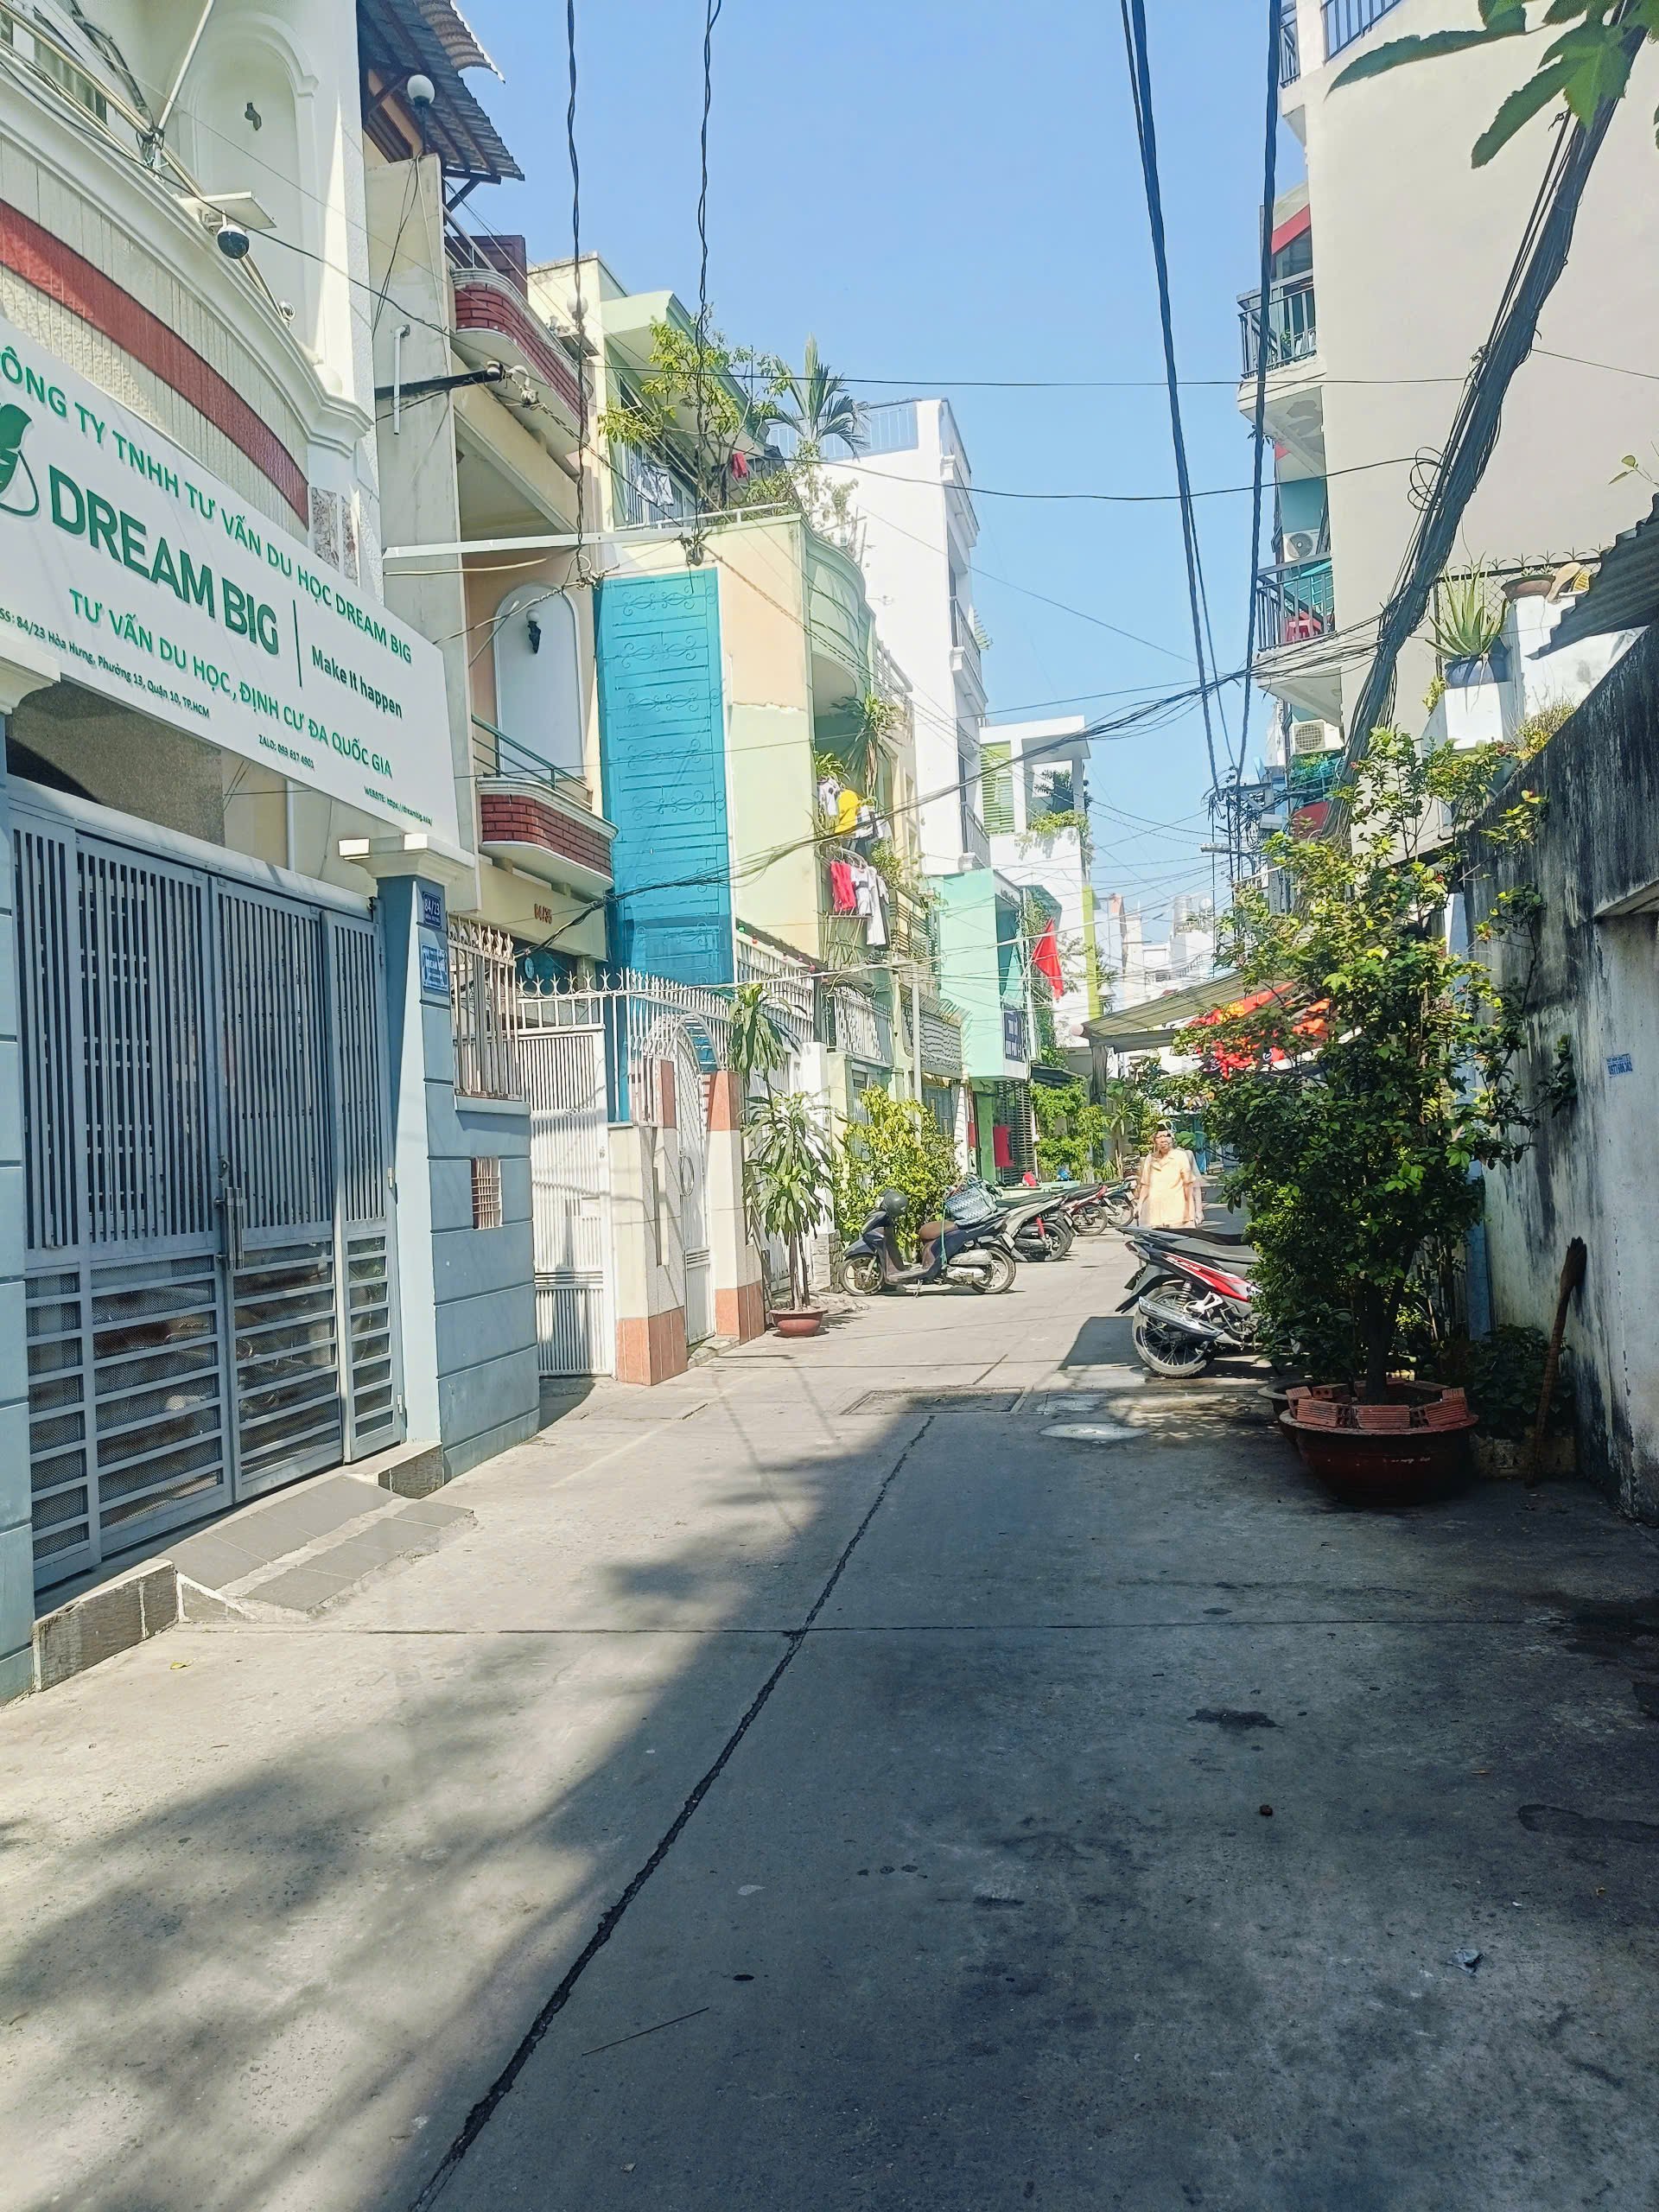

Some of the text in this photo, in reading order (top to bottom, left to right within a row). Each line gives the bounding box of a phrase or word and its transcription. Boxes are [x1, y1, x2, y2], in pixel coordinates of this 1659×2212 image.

[0, 346, 412, 664] ÔNG TY TNHH TƯ VẤN DU HỌC DREAM BIG
[48, 464, 279, 656] DREAM BIG
[16, 615, 46, 639] 84/23
[48, 631, 67, 650] Hòa
[68, 640, 96, 665] Hưng,
[98, 655, 132, 683] Phường
[133, 673, 147, 689] 13,
[147, 679, 168, 699] Quận
[170, 690, 181, 705] 10,
[181, 696, 210, 718] TP.HCM
[69, 588, 103, 624] TƯ
[108, 609, 153, 653] VẤN
[159, 637, 187, 670] DU
[238, 681, 279, 720] ĐỊNH
[283, 706, 305, 731] CƯ
[308, 718, 329, 747] ĐA
[332, 732, 369, 766] QUỐC
[372, 753, 393, 779] GIA
[311, 645, 347, 684] Make
[359, 675, 403, 719] happen
[424, 898, 441, 916] 84/23
